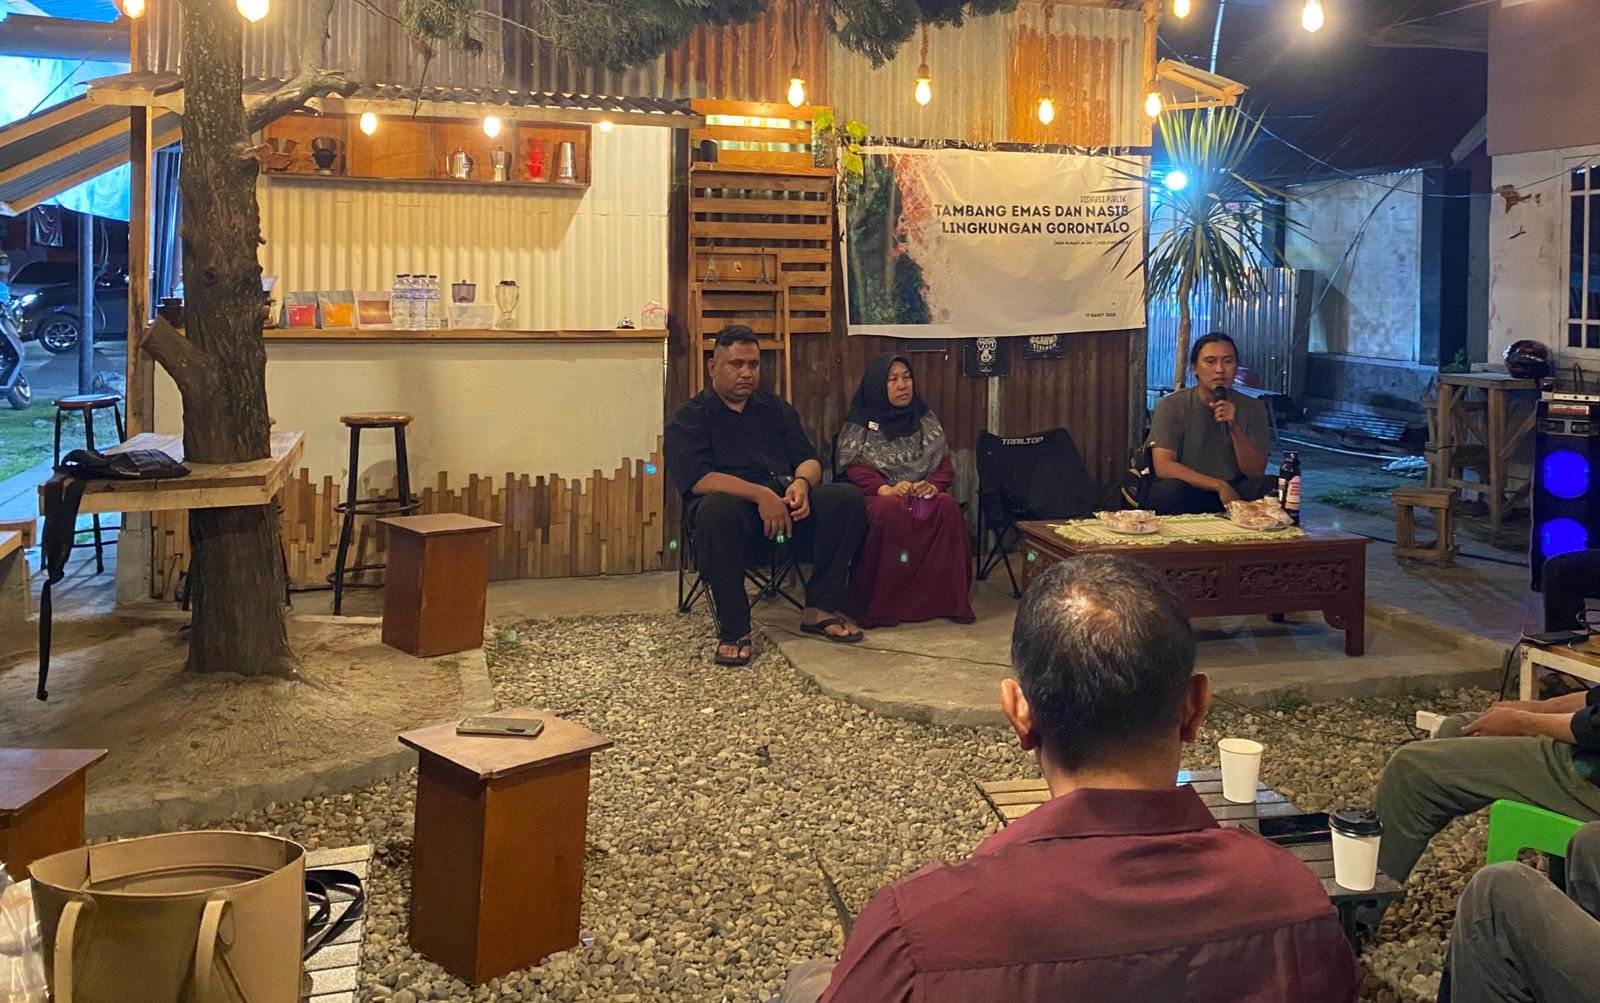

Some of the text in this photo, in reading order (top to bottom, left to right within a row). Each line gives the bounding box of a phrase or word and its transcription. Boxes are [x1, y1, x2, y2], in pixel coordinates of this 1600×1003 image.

[1080, 195, 1127, 203] DISKUSI PUBLIK
[934, 204, 1129, 217] TAMBANG EMAS DAN NASIB
[942, 221, 1130, 234] LINGKUNGAN GORONTALO
[977, 339, 996, 350] YOU
[1001, 436, 1044, 446] TRAILTOP
